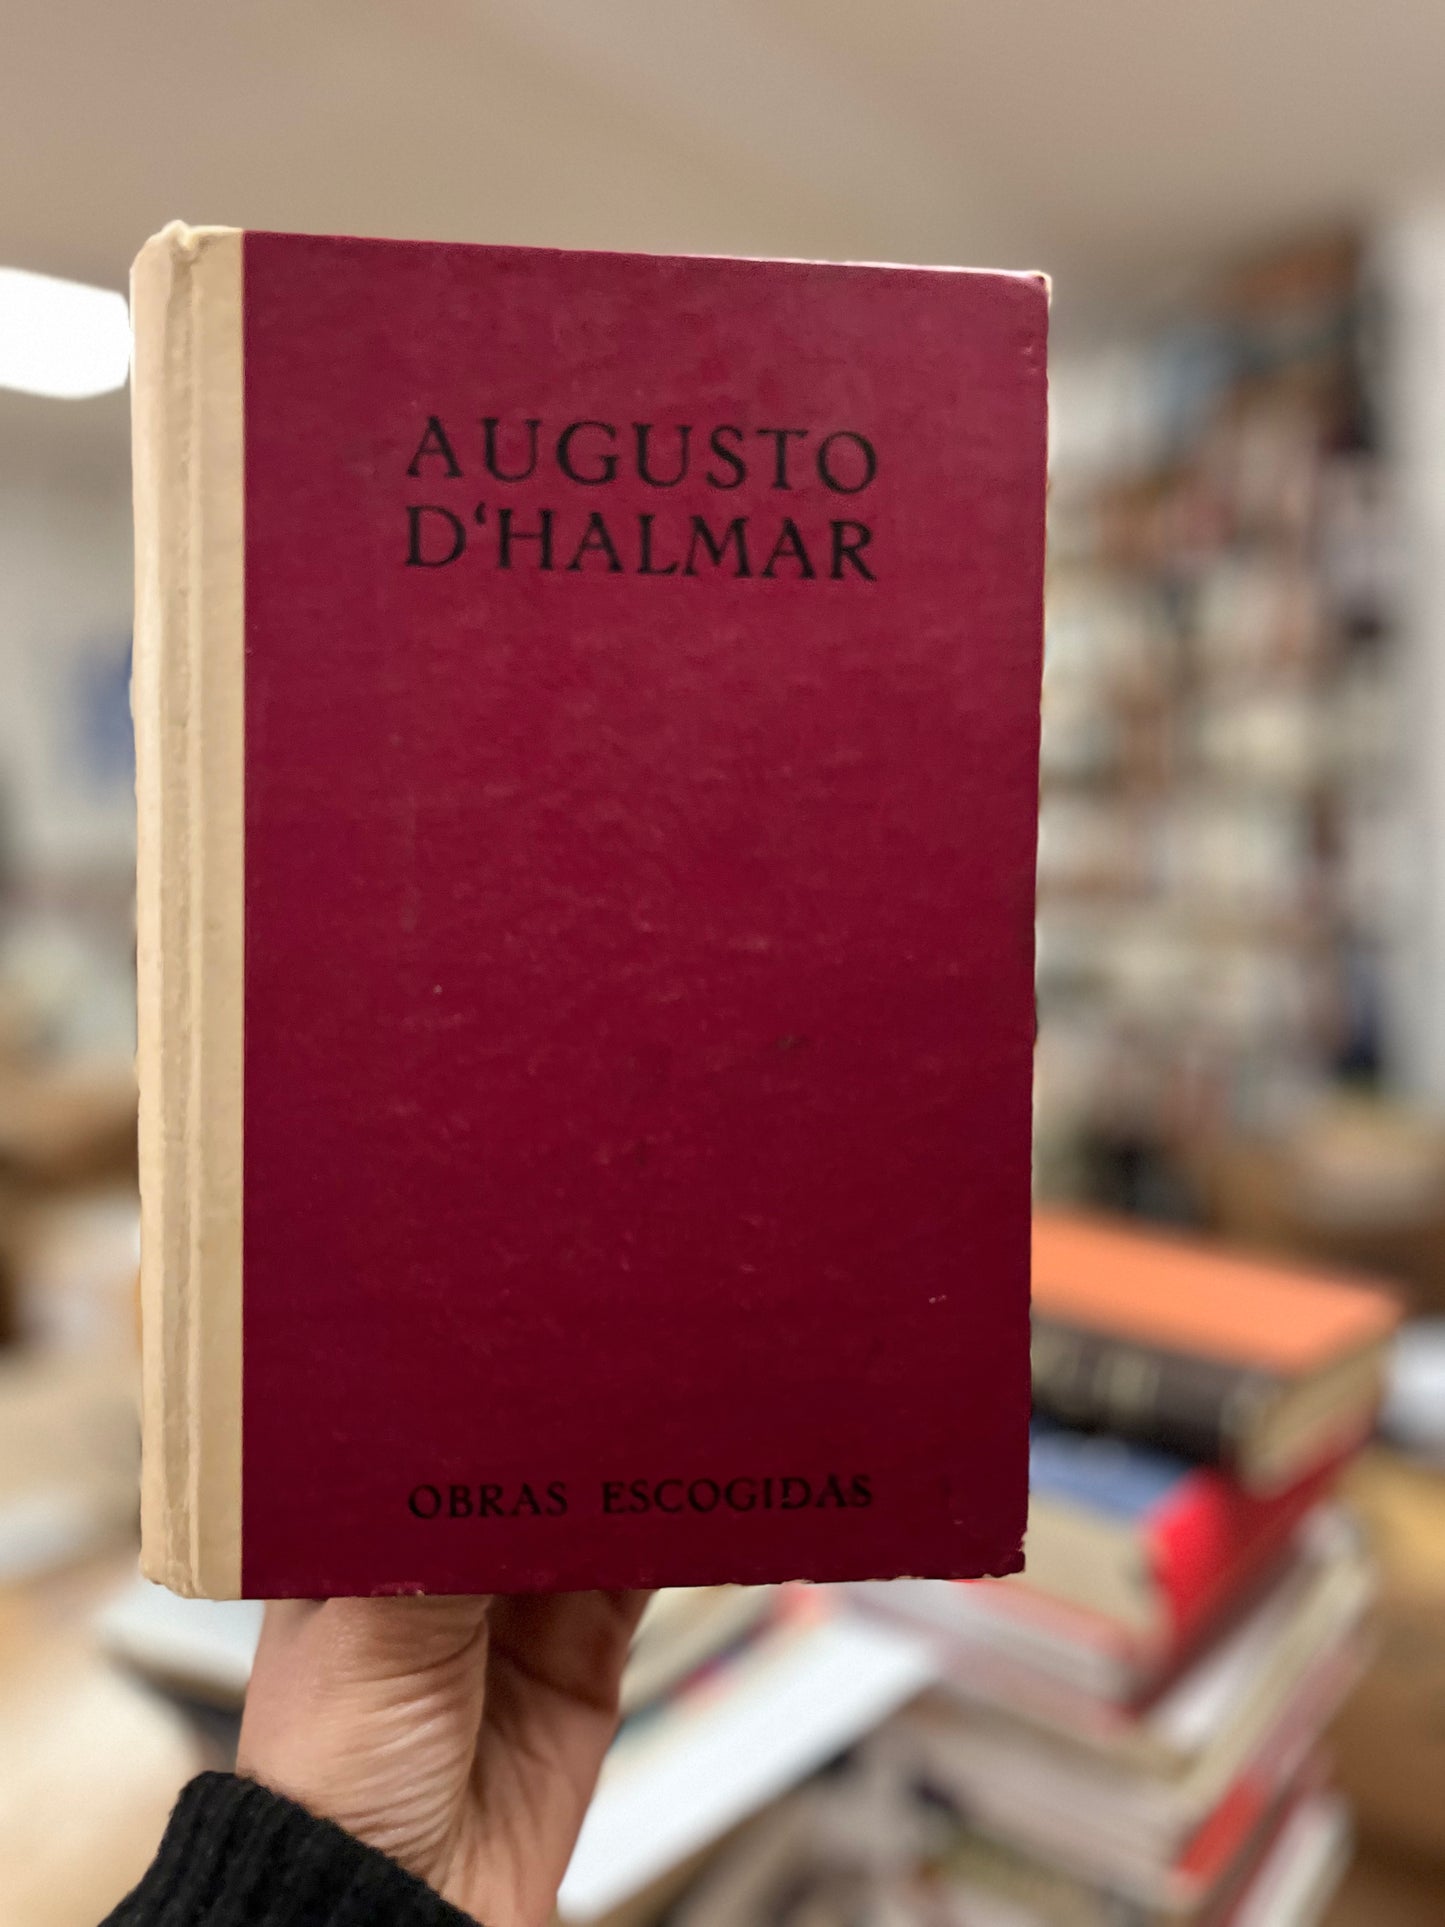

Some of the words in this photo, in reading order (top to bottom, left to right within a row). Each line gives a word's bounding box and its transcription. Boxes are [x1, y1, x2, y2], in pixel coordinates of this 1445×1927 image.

[405, 414, 879, 496] AUGUSTO
[403, 501, 878, 583] D'HALMAR
[407, 1482, 568, 1520] OBRAS
[601, 1474, 873, 1514] ESCOGIDAS
